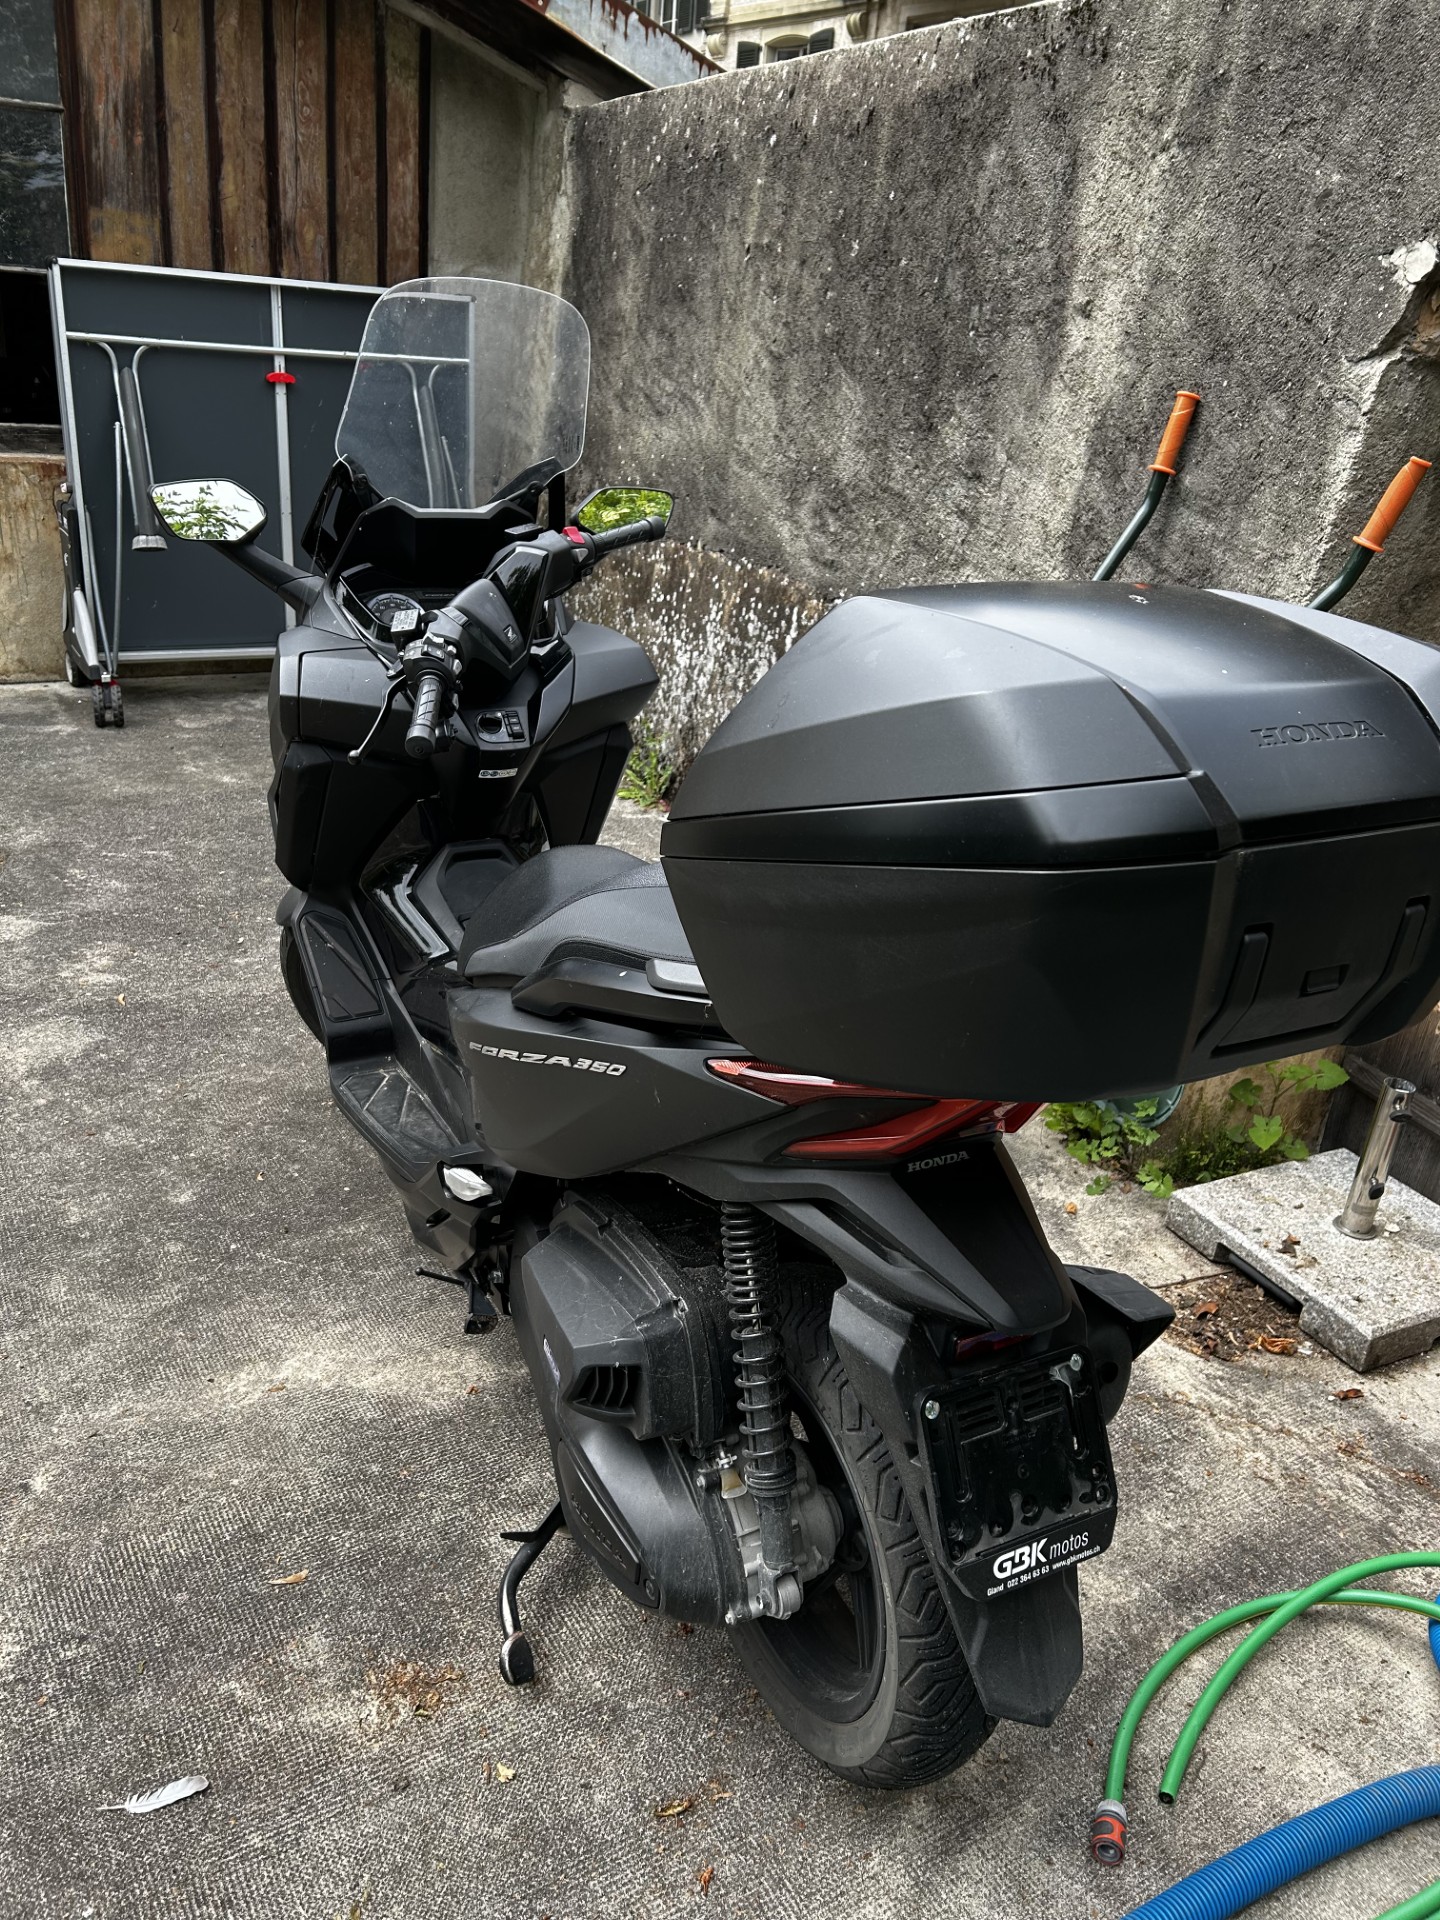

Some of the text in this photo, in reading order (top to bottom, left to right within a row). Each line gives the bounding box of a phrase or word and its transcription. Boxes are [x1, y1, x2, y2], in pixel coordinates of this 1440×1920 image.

[1250, 720, 1385, 748] HONDA
[907, 1150, 970, 1173] HONDA
[987, 1545, 1101, 1596] Gland 022 364 63 63 www.gbkmotos.ch
[993, 1531, 1089, 1579] GBK motos
